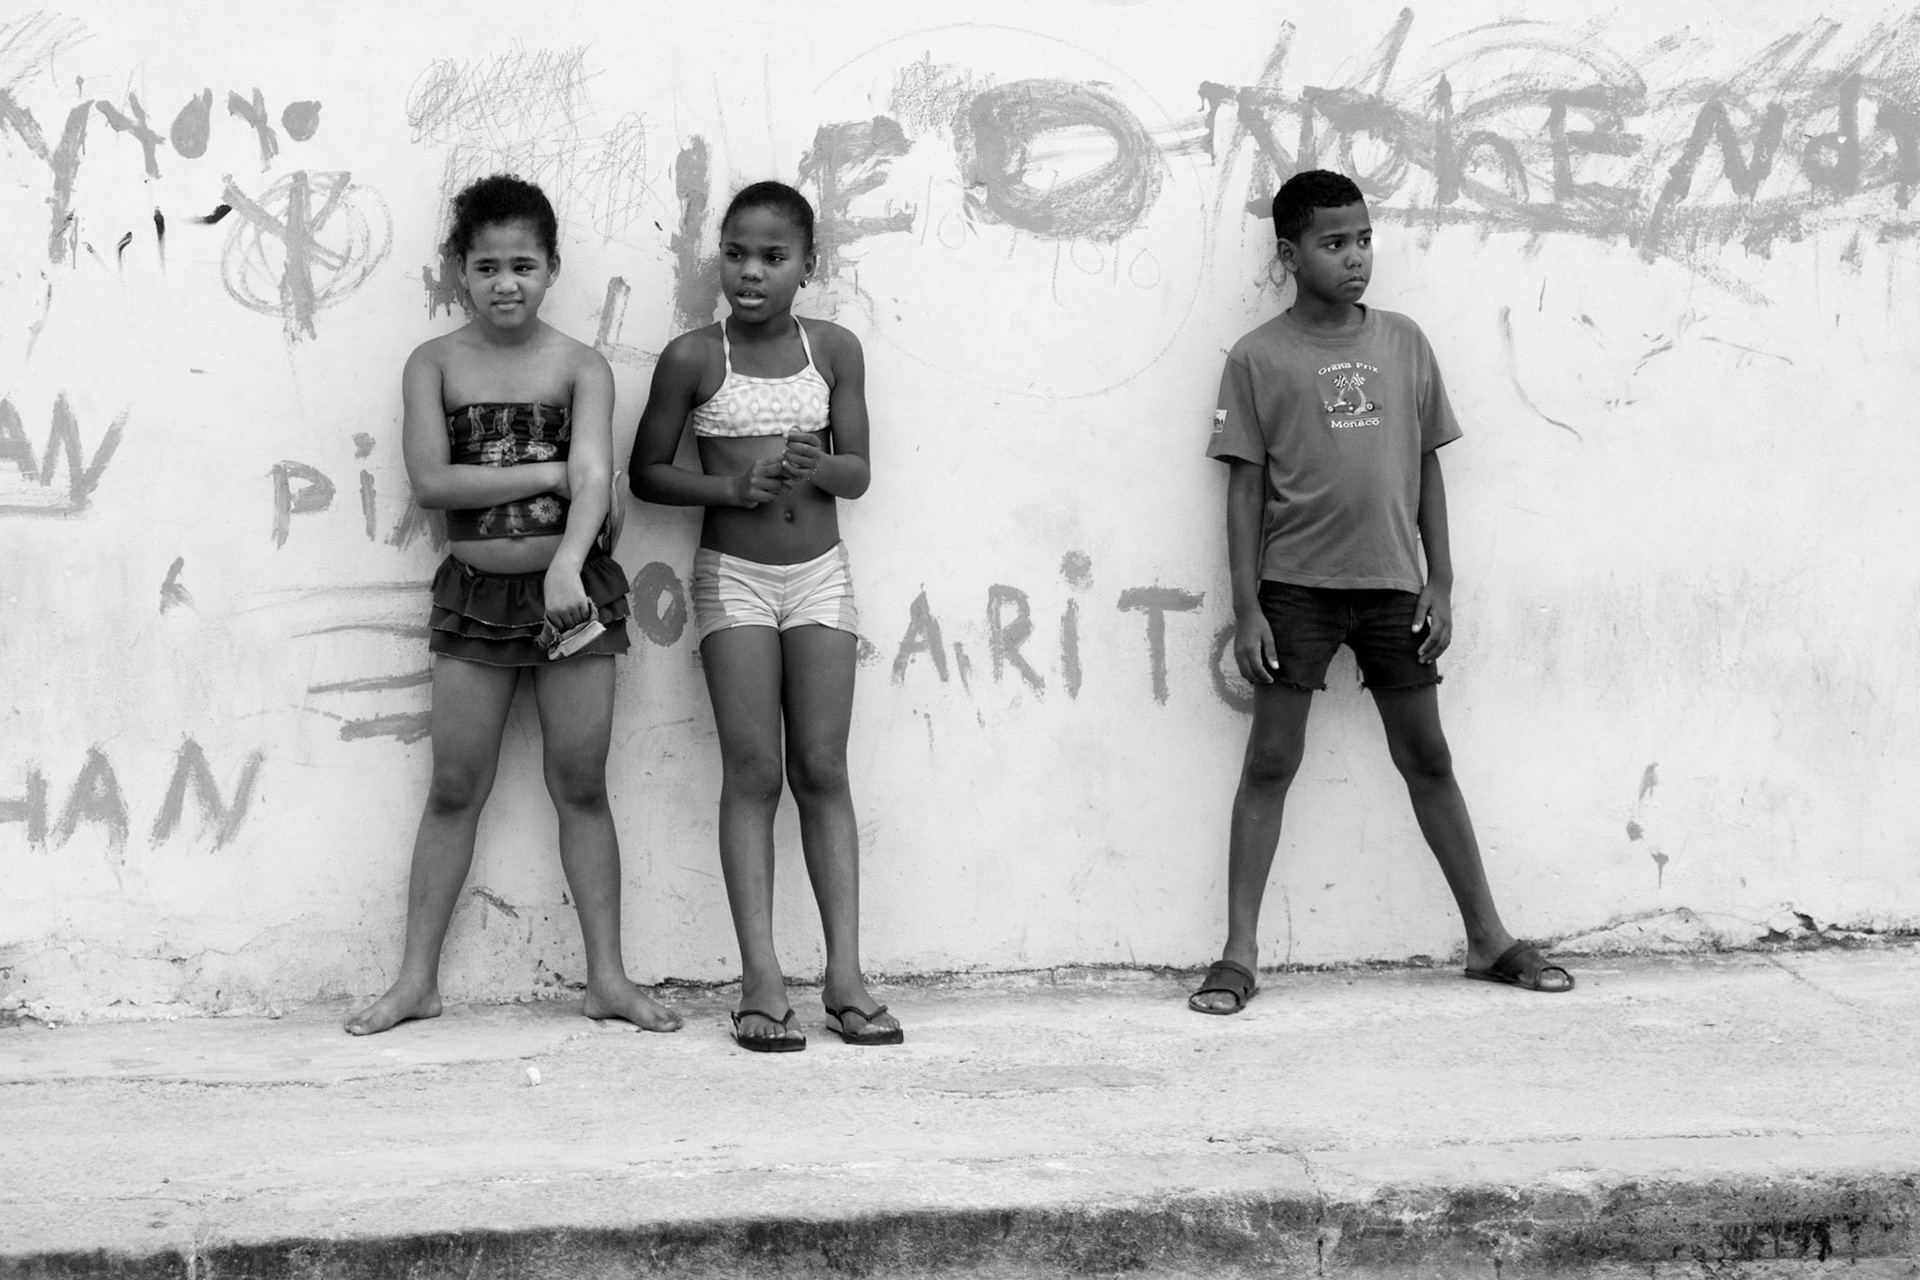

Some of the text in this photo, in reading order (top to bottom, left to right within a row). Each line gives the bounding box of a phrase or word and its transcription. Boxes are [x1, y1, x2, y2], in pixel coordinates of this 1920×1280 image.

[1318, 362, 1379, 375] Grand Prix
[1330, 419, 1380, 429] Monaco
